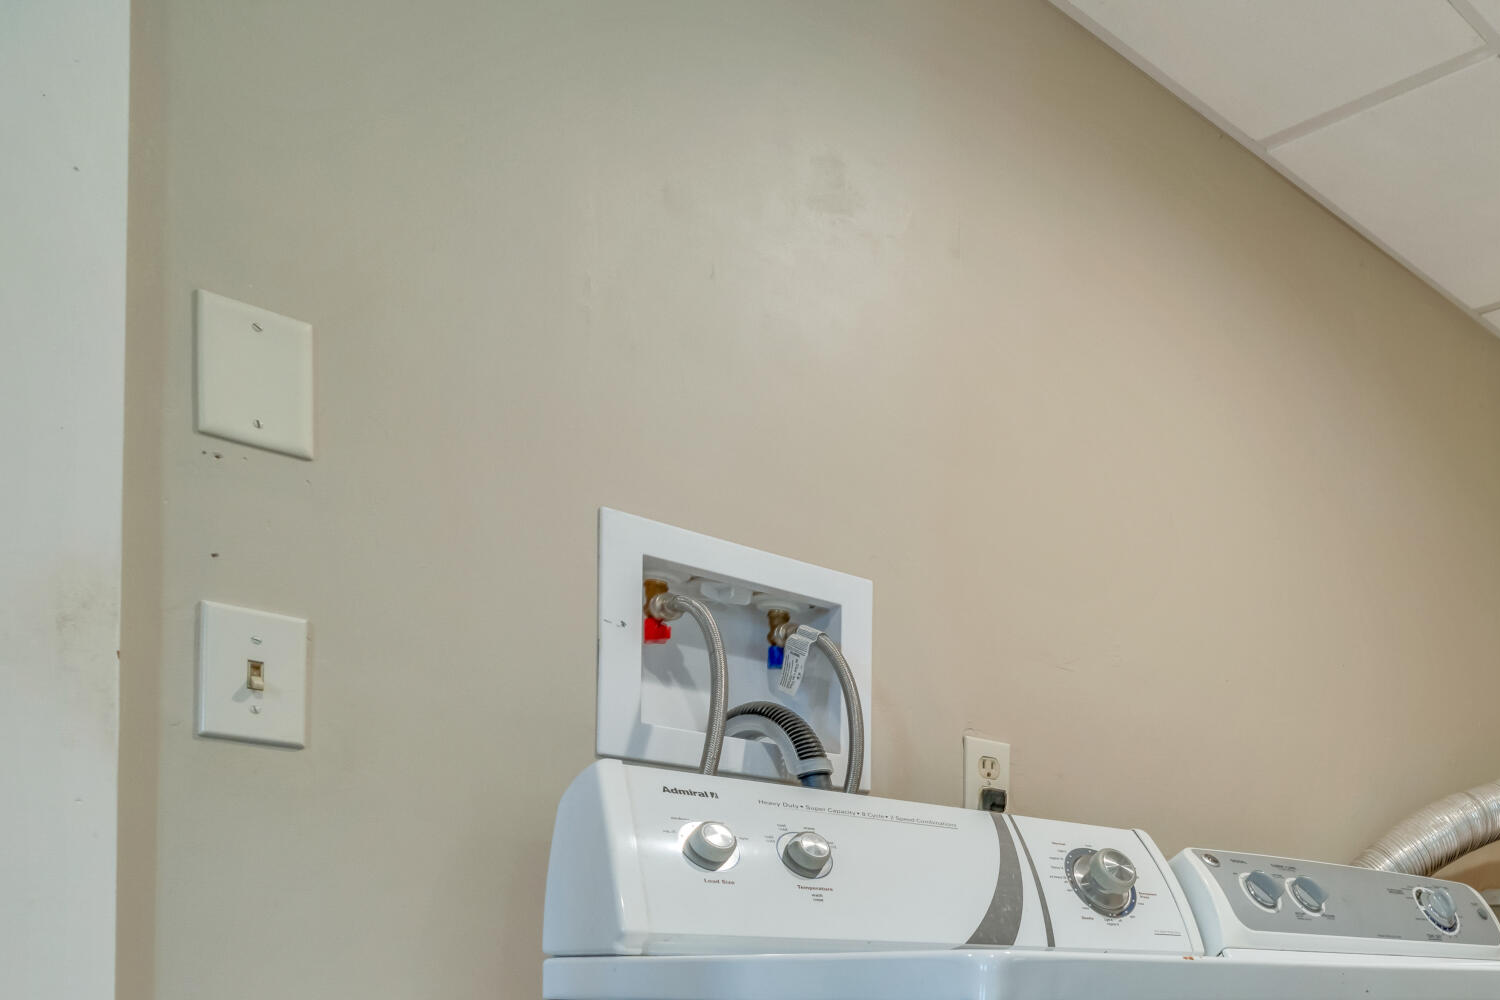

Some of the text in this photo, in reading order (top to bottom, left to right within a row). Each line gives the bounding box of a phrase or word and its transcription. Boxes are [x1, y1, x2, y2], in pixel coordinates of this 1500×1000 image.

[662, 785, 709, 798] Admiral
[758, 799, 781, 808] Heavy
[805, 804, 826, 812] Super
[827, 807, 856, 816] Capacity
[796, 884, 834, 892] Temperature
